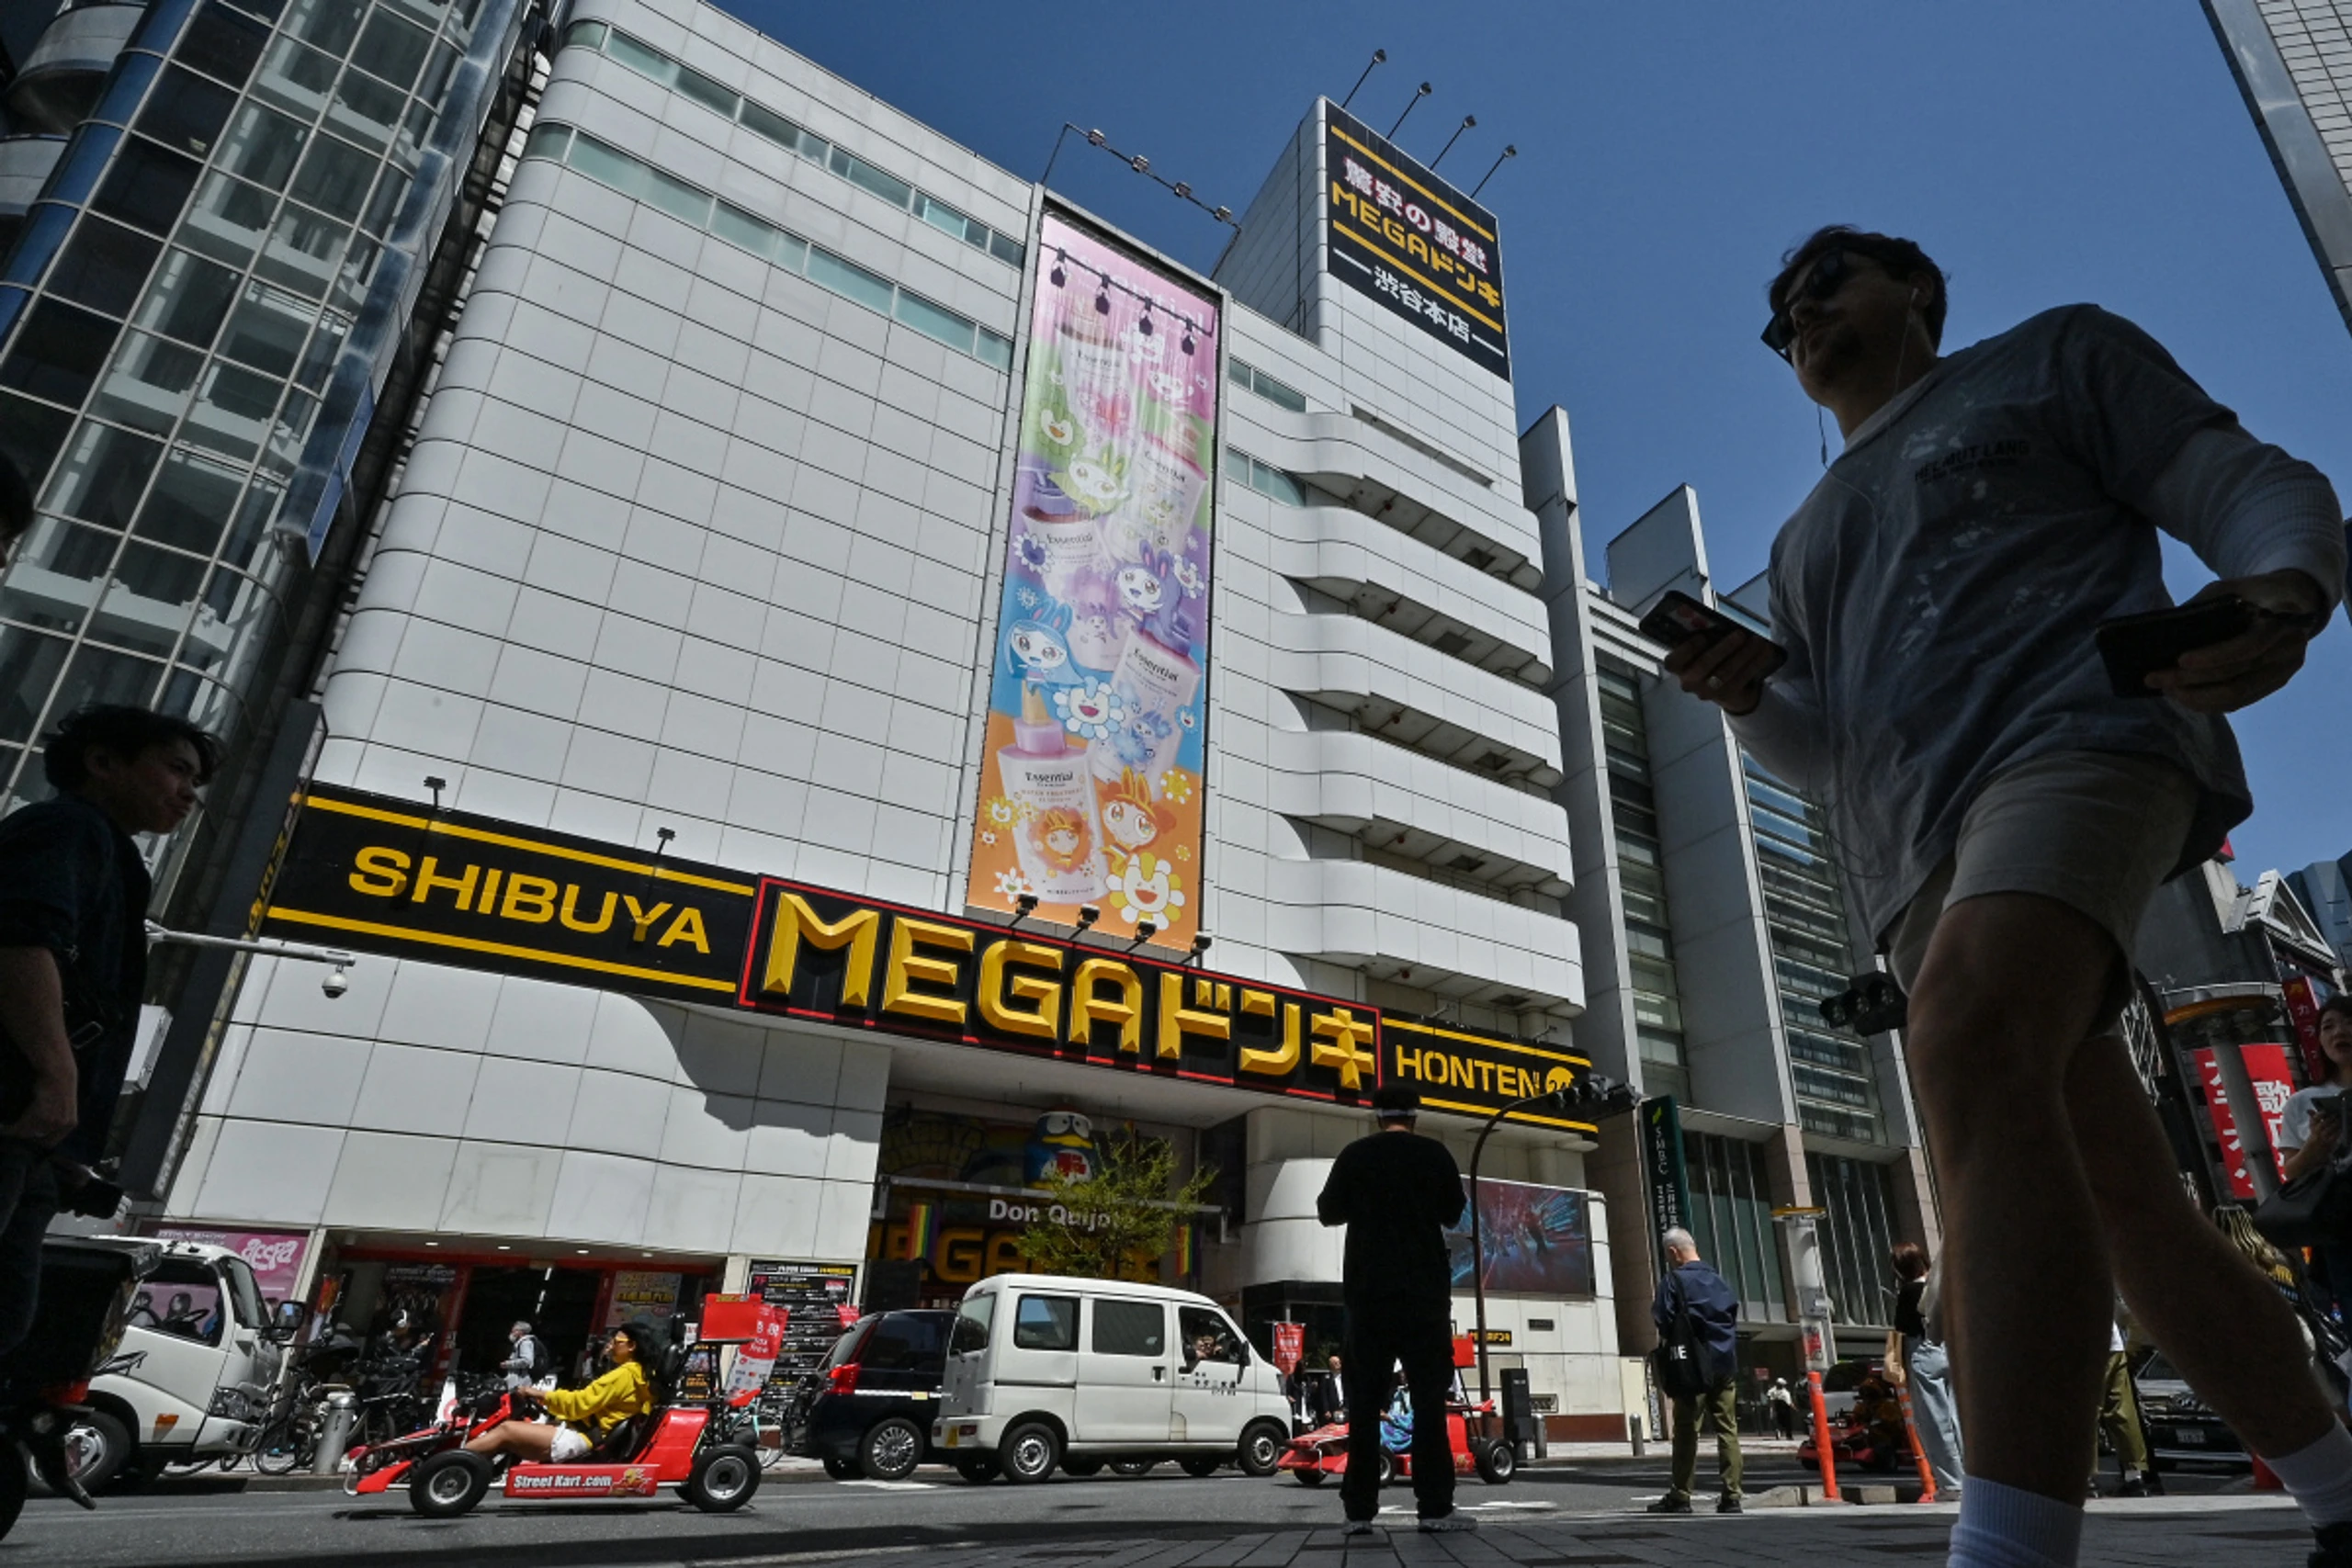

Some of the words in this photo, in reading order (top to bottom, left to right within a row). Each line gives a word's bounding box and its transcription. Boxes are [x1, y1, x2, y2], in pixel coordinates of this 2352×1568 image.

[1332, 180, 1501, 308] MEGAドンキ
[1343, 155, 1488, 275] 驚安の殿堂
[1374, 265, 1471, 344] 渋谷本店
[348, 844, 712, 955] SHIBUYA
[763, 891, 1375, 1091] MEGAドンキ
[1395, 1043, 1541, 1100] HONTEN
[989, 1199, 1039, 1224] Don
[1048, 1204, 1120, 1232] Quijo
[514, 1474, 552, 1488] Street
[554, 1474, 582, 1487] Kart
[582, 1475, 613, 1487] .com
